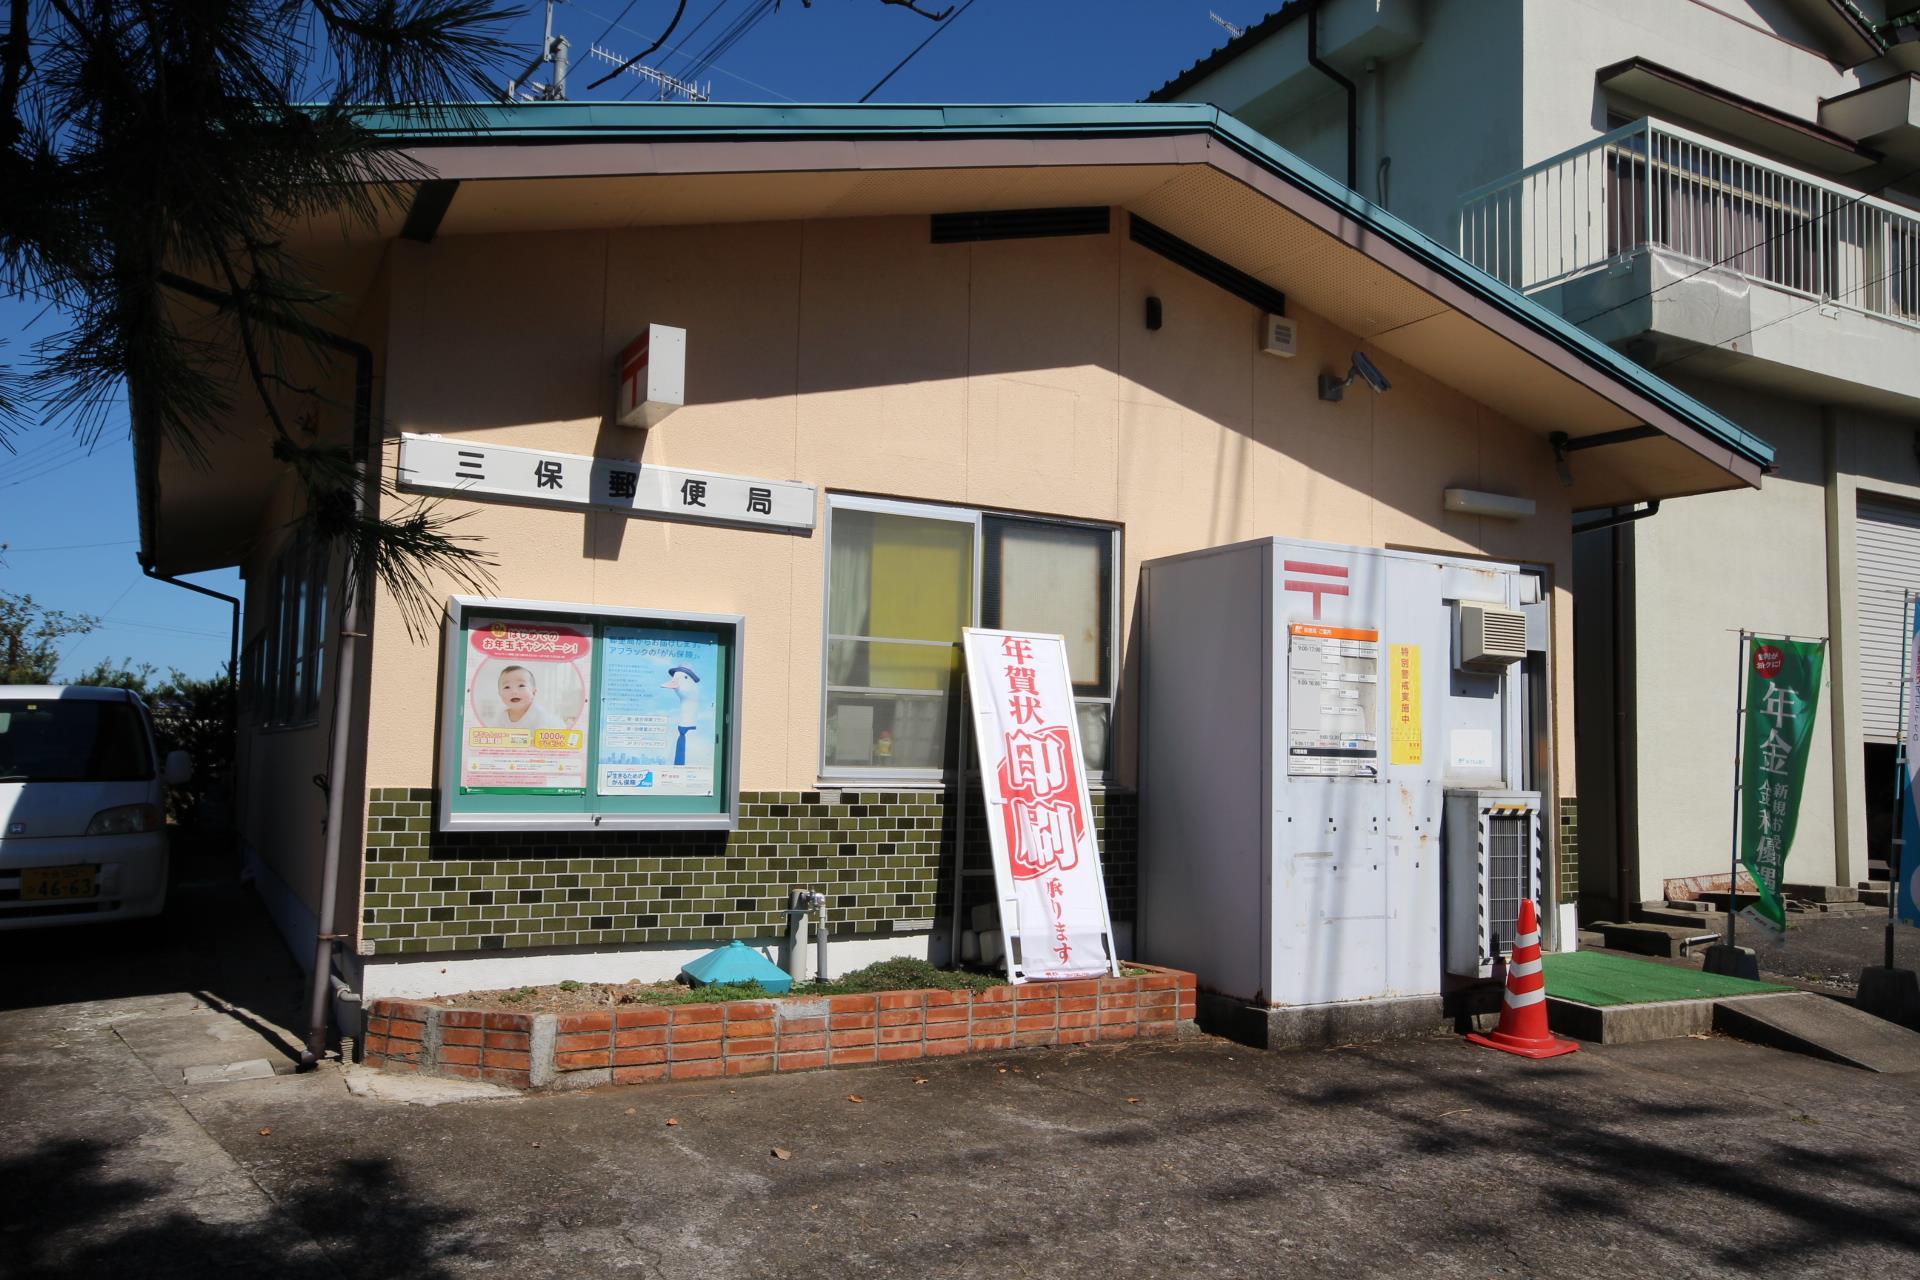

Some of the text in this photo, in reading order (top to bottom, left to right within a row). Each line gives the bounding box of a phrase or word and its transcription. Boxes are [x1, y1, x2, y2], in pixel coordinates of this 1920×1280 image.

[455, 449, 772, 515] 三保郵便局
[1001, 635, 1045, 726] 年賀状
[1759, 681, 1799, 776] 年金
[1004, 729, 1079, 872] 印刷
